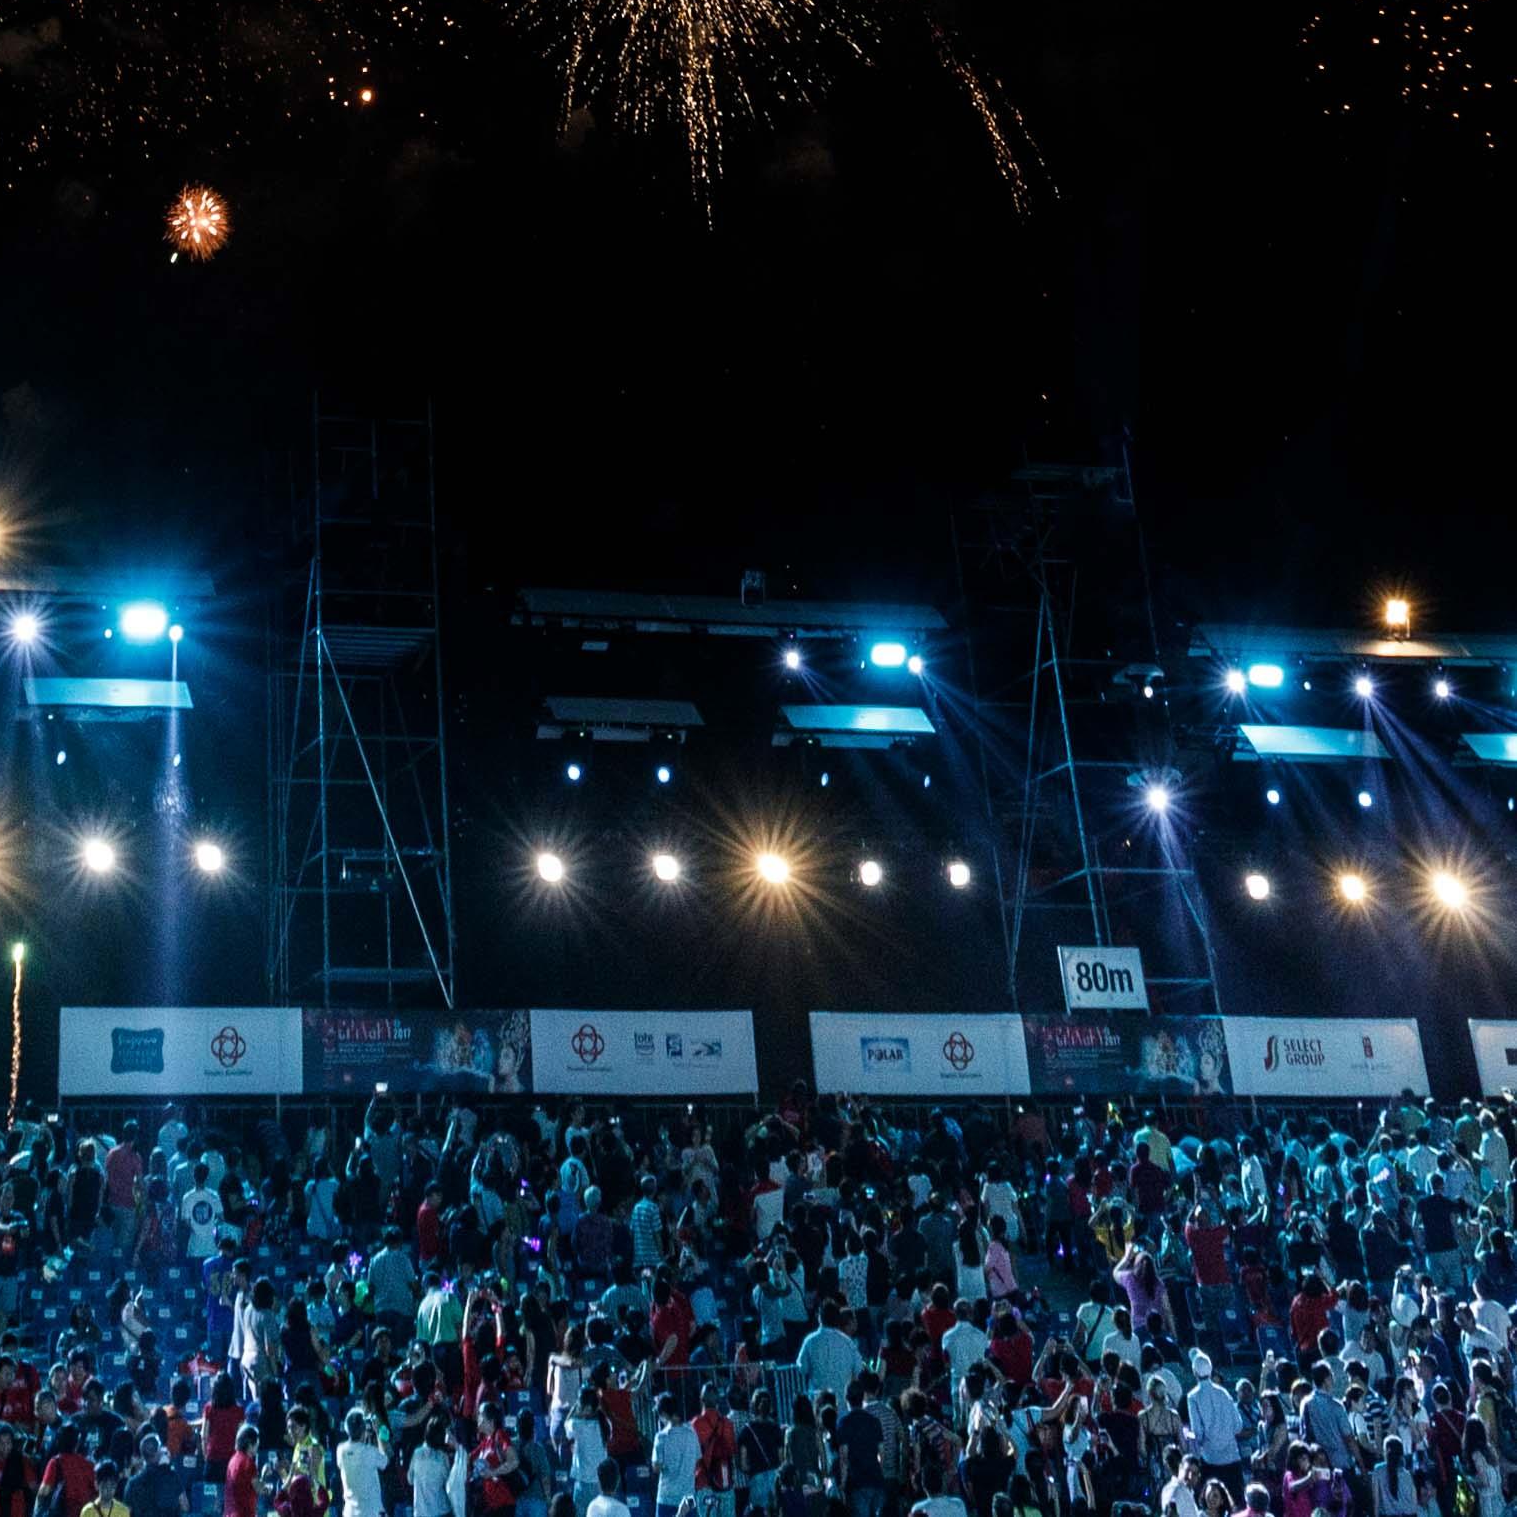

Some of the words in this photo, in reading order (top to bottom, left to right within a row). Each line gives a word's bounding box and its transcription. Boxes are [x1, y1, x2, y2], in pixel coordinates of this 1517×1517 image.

[1075, 961, 1134, 993] 80m
[1283, 1038, 1323, 1053] SELECT
[867, 1048, 904, 1062] POLAR
[1285, 1052, 1326, 1067] GROUP
